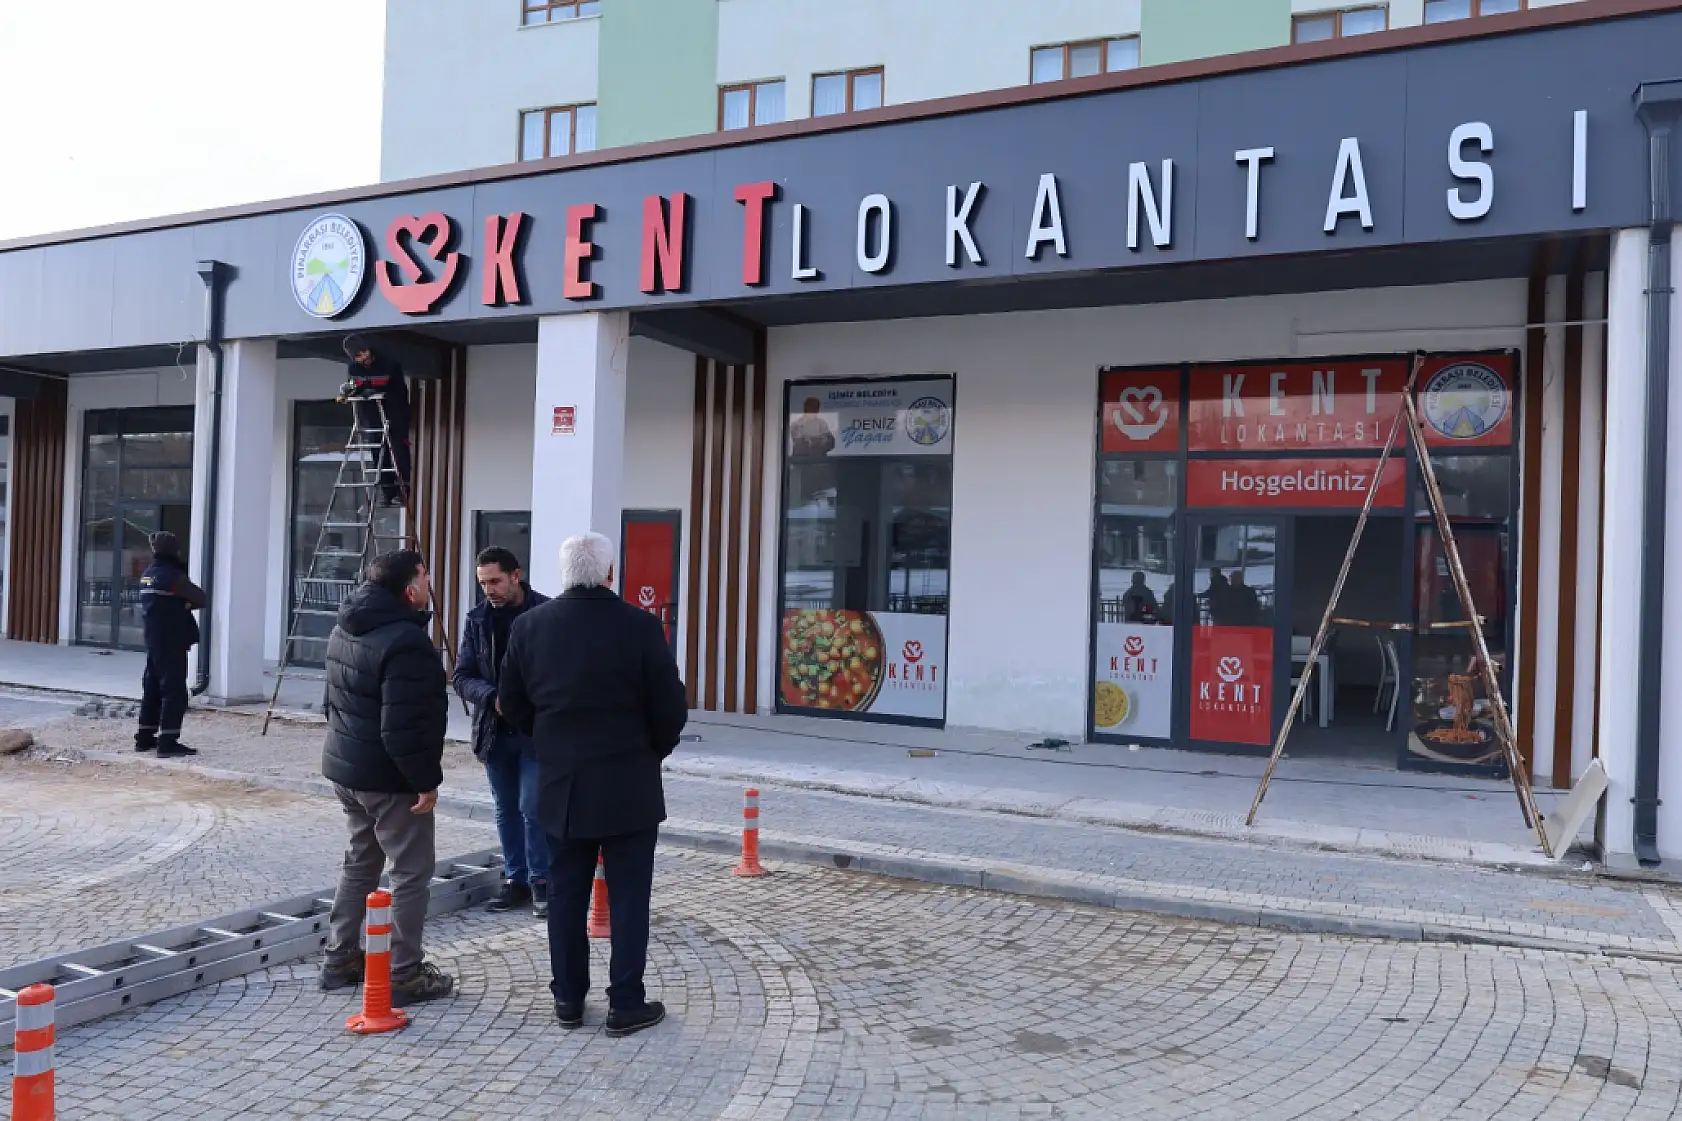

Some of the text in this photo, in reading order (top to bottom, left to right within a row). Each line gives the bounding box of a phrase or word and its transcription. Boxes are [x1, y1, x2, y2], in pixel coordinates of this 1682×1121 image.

[482, 109, 1589, 306] KENT LOKANTASI
[1222, 369, 1382, 417] KENT
[852, 416, 897, 431] DENİZ
[1220, 421, 1382, 444] LOKANTASI
[1221, 470, 1367, 495] Hoşgeldiniz
[888, 662, 938, 682] KENT
[1109, 656, 1159, 674] KENT
[1200, 682, 1261, 704] KENT
